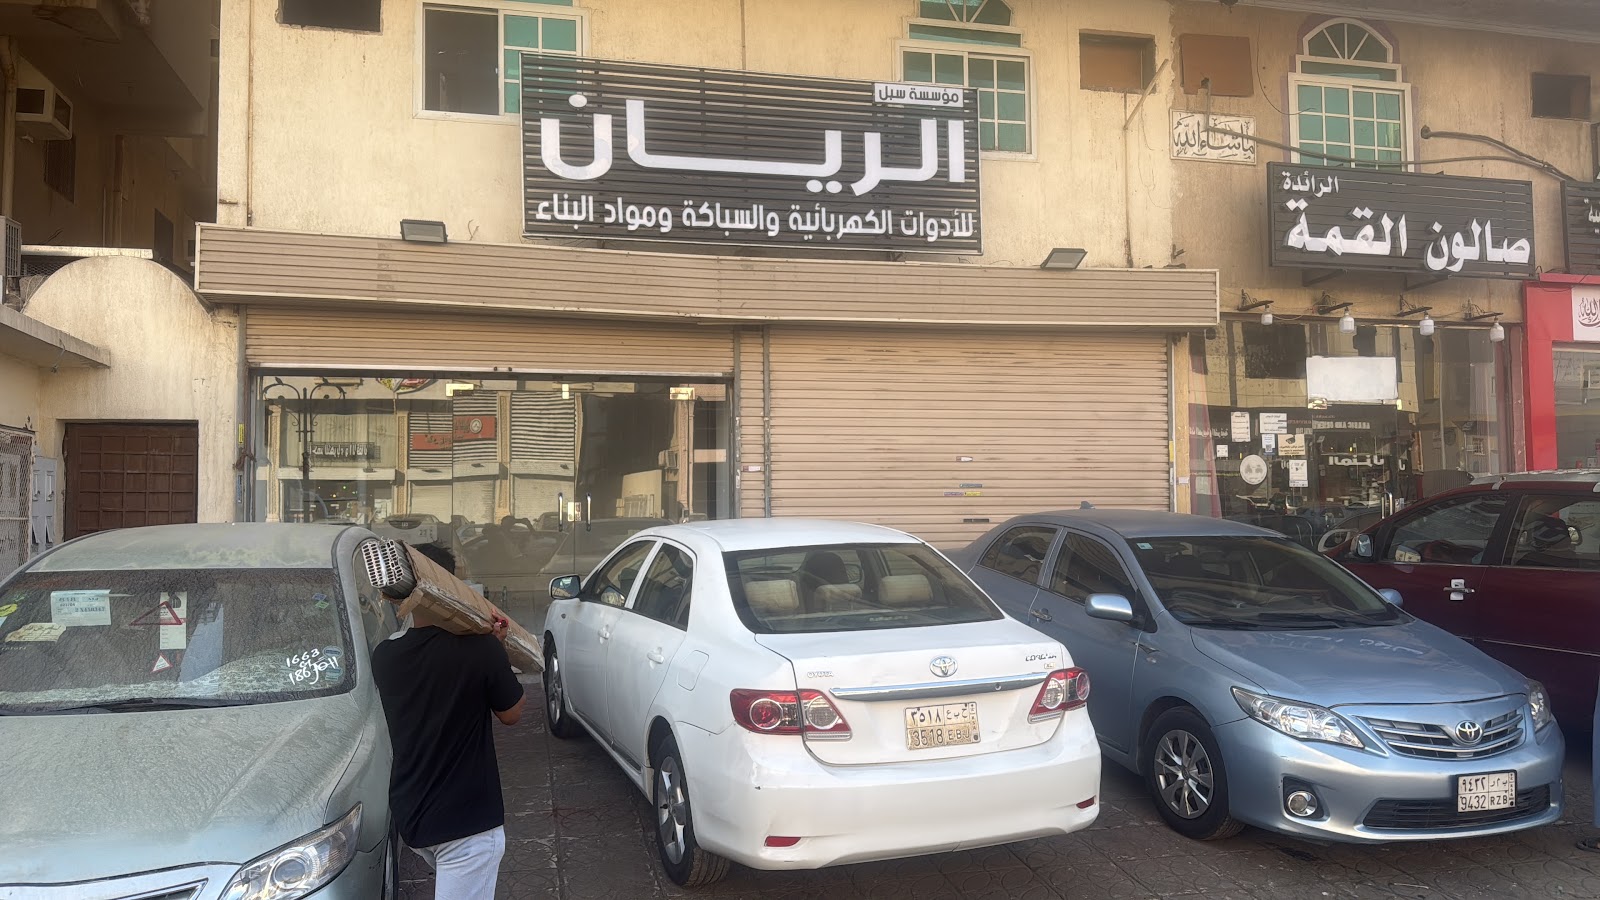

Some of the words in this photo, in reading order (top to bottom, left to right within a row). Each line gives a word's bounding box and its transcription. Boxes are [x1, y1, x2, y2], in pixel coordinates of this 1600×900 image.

[879, 86, 906, 101] سبل
[909, 87, 959, 104] مؤسسة
[541, 94, 965, 196] الريان
[1282, 170, 1339, 197] الرائدة
[536, 193, 594, 230] البناء
[604, 197, 672, 233] ومواد
[682, 200, 780, 237] والسباكة
[788, 203, 893, 240] الكهربائية
[901, 208, 973, 242] للأدوات
[1286, 198, 1407, 256] القمة
[1427, 218, 1530, 272] صالون
[286, 648, 320, 667] 1663
[912, 728, 944, 747] 3518
[1460, 794, 1487, 811] 9432
